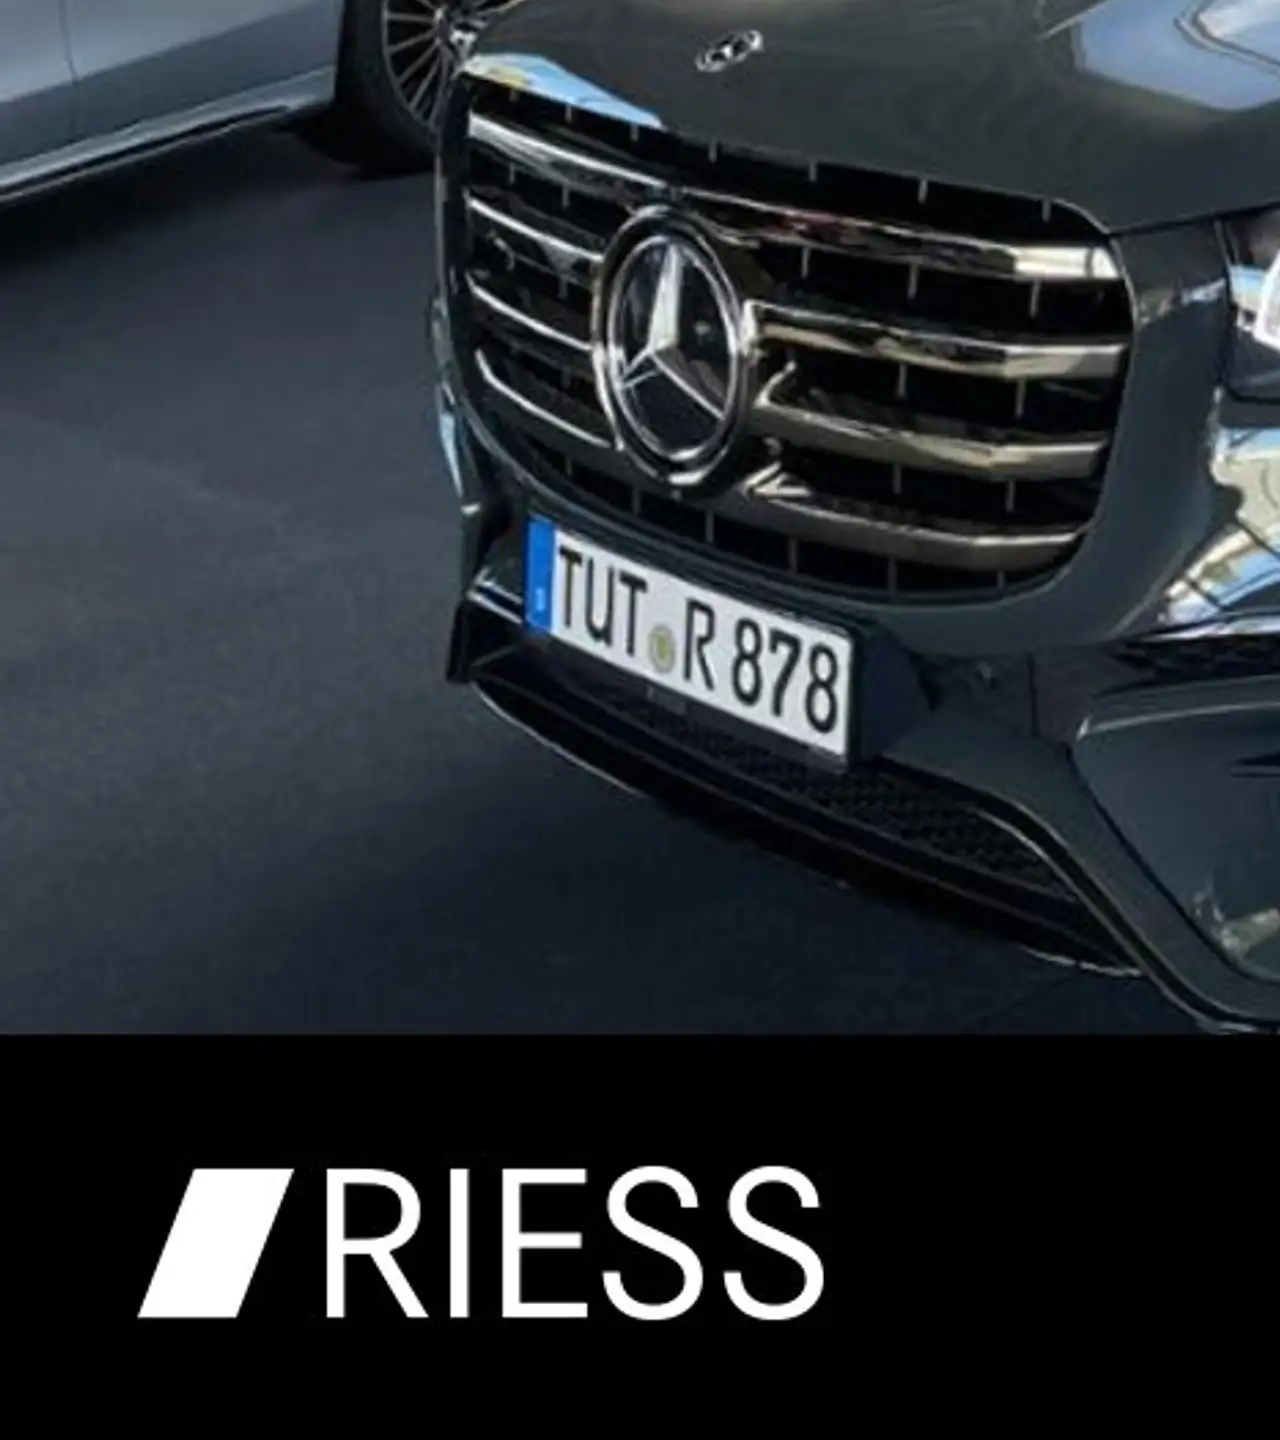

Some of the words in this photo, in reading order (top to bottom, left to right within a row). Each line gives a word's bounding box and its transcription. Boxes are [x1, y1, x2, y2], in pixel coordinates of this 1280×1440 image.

[558, 545, 648, 658] TUT
[682, 597, 716, 691] R
[731, 617, 839, 734] 878
